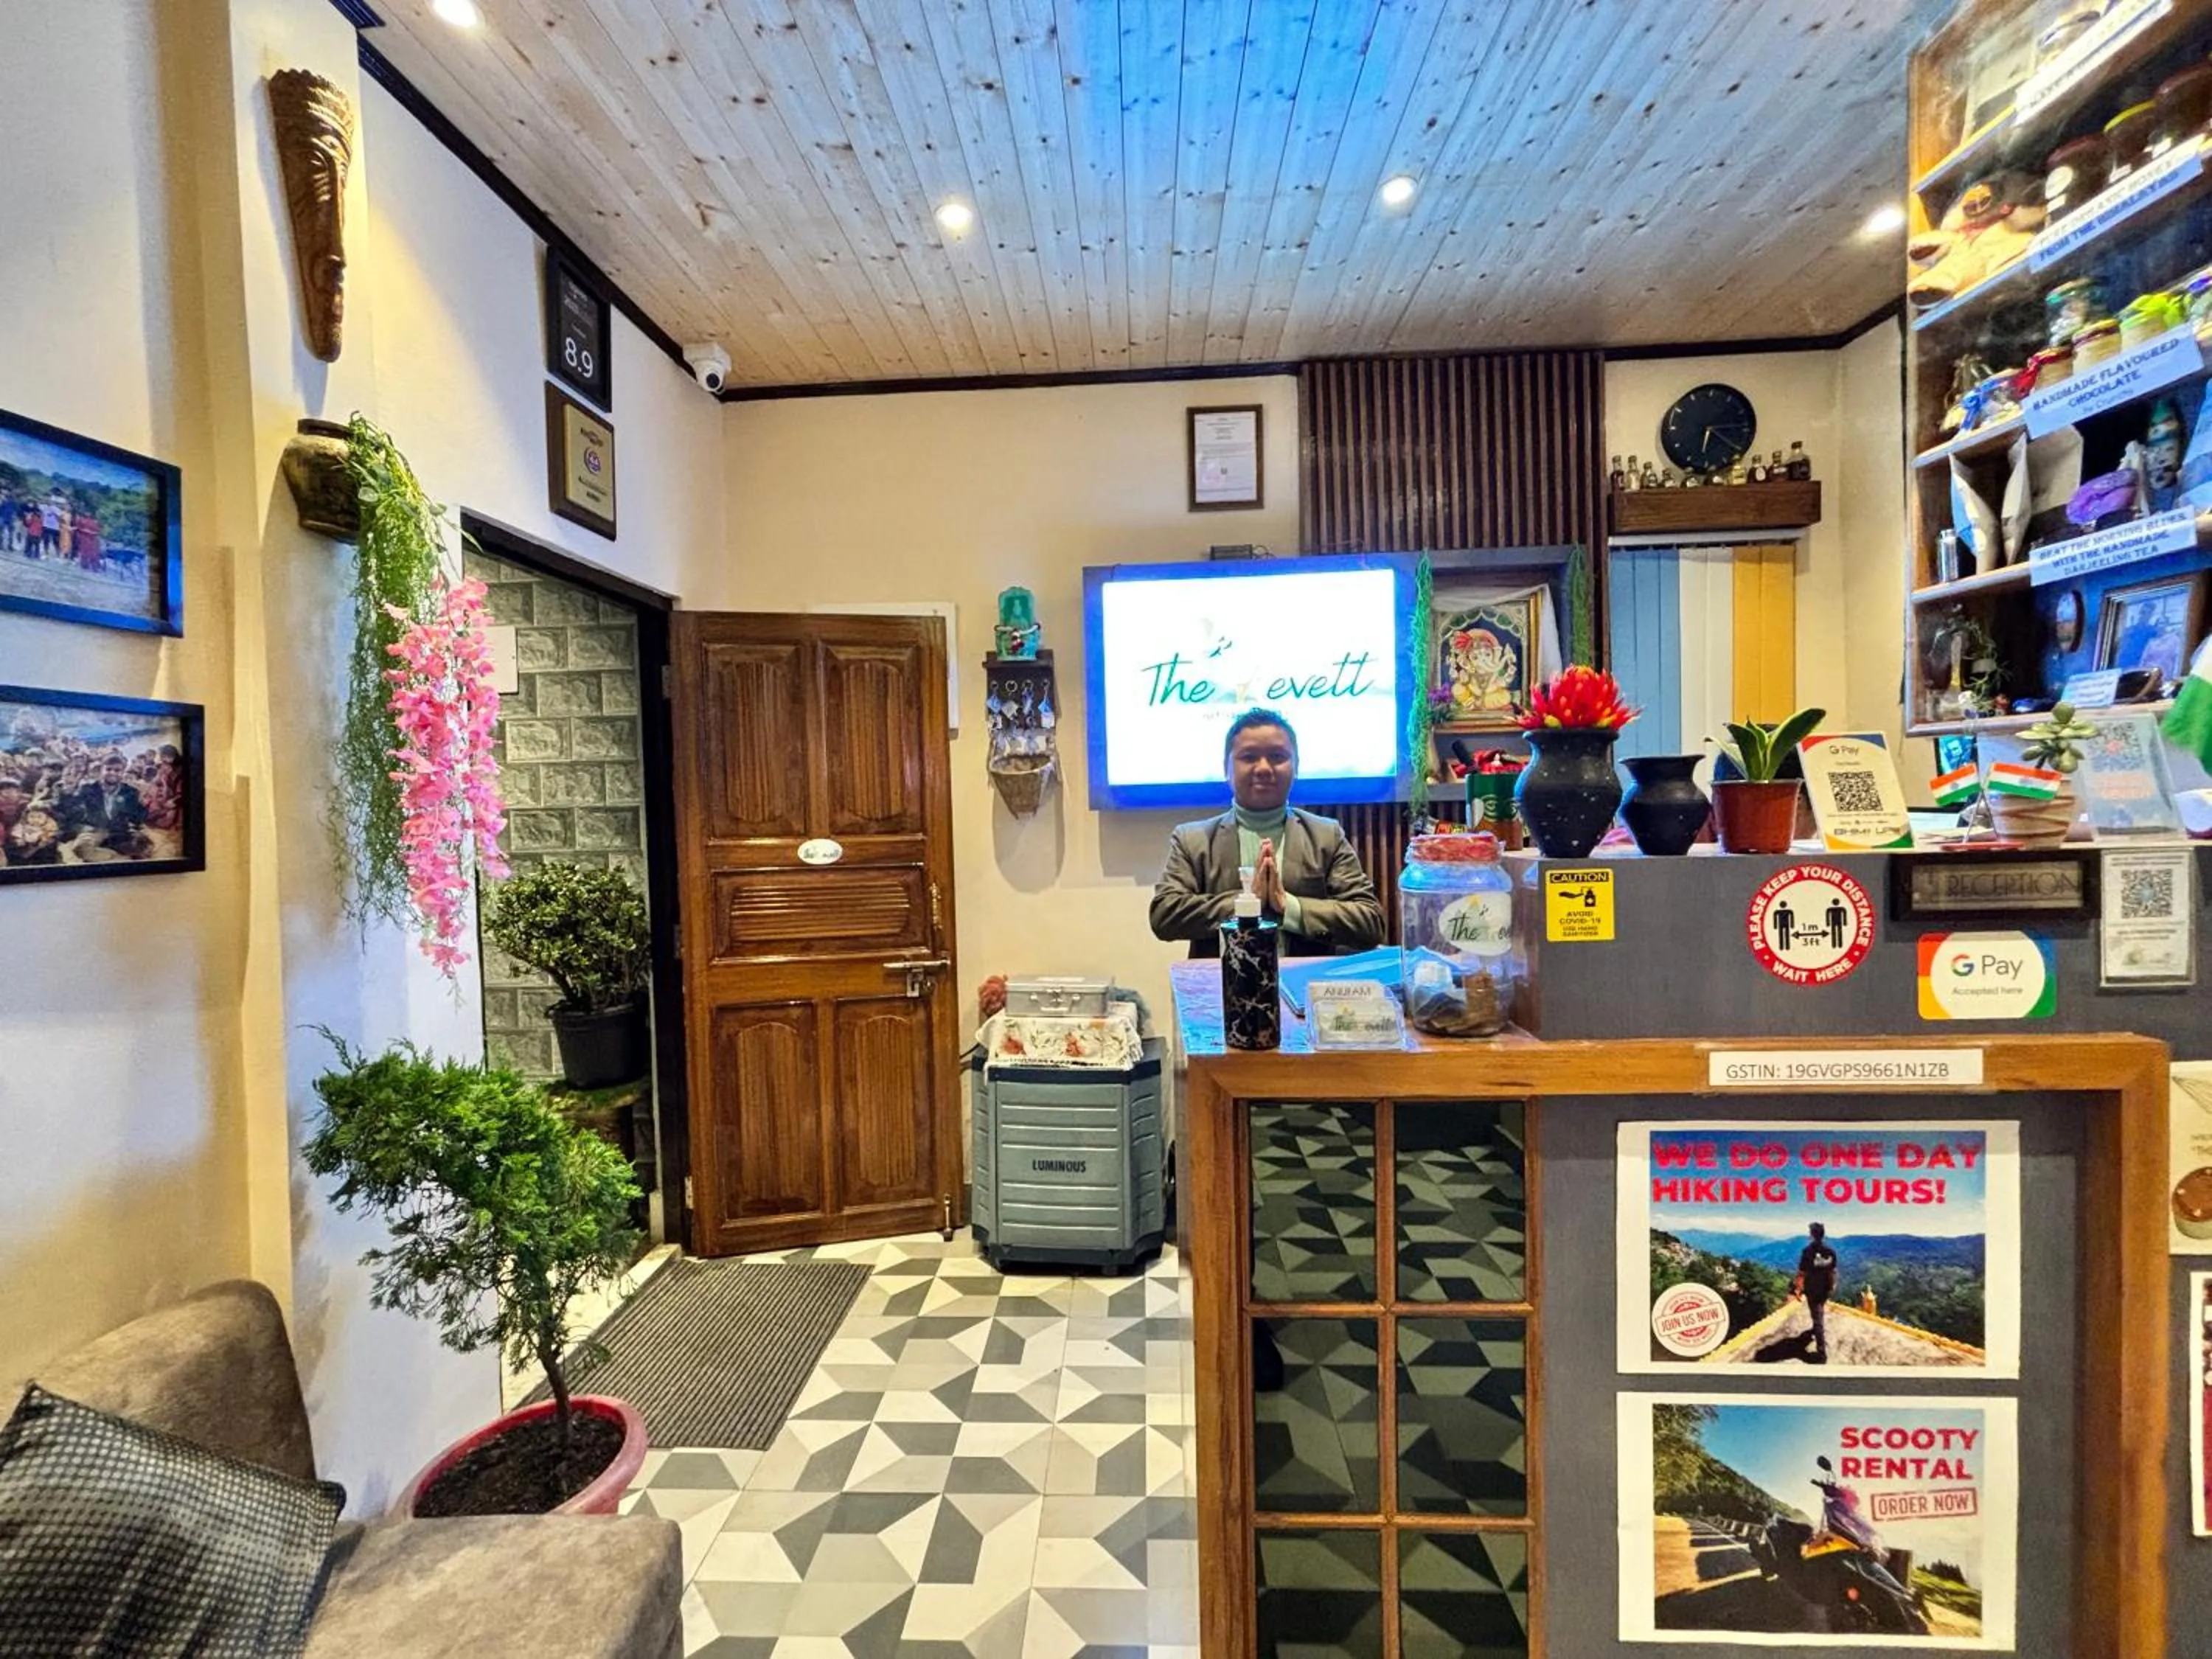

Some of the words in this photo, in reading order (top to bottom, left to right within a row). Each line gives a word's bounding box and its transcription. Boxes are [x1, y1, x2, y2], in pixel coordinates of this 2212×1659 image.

[565, 340, 594, 378] 8.9
[2033, 375, 2098, 411] HANDMADE
[2099, 338, 2180, 380] FLAVOURED
[2068, 370, 2141, 408] CHOCOLATE
[2080, 549, 2099, 562] THE
[2104, 530, 2171, 553] HANDMADE
[2064, 552, 2131, 576] DARJEELING
[2135, 544, 2159, 557] TEA
[1141, 653, 1216, 706] The
[1551, 872, 1607, 883] CAUTION
[1944, 872, 2080, 897] RECEPTION
[1749, 895, 1768, 950] PLEASE
[1761, 869, 1798, 897] KEEP
[1800, 866, 1843, 884] YOUR
[1841, 878, 1873, 947] DISTANCE
[1447, 912, 1478, 941] The
[1772, 960, 1809, 982] WAIT
[1815, 957, 1854, 982] HERE
[1980, 954, 2023, 981] Pay
[1952, 986, 1999, 997] Accepted
[2000, 985, 2023, 995] here
[1726, 1064, 1781, 1079] GSTIN:
[1787, 1062, 1950, 1079] 19GVGPS9661N1ZB
[1032, 1159, 1086, 1173] LUMINOUS
[1651, 1142, 1718, 1169] WE
[1730, 1142, 1789, 1169] DO
[1800, 1142, 1885, 1169] ONE
[1896, 1142, 1983, 1169] DAY
[1652, 1177, 1789, 1203] HIKING
[1798, 1178, 1947, 1204] TOURS!
[1661, 1317, 1681, 1332] JOIN
[1682, 1312, 1696, 1326] US
[1697, 1307, 1719, 1322] NOW
[1840, 1427, 1979, 1450] SCOOTY
[1840, 1456, 1974, 1480] RENTAL
[1878, 1496, 1928, 1516] ORDER
[1933, 1493, 1969, 1512] NOW
